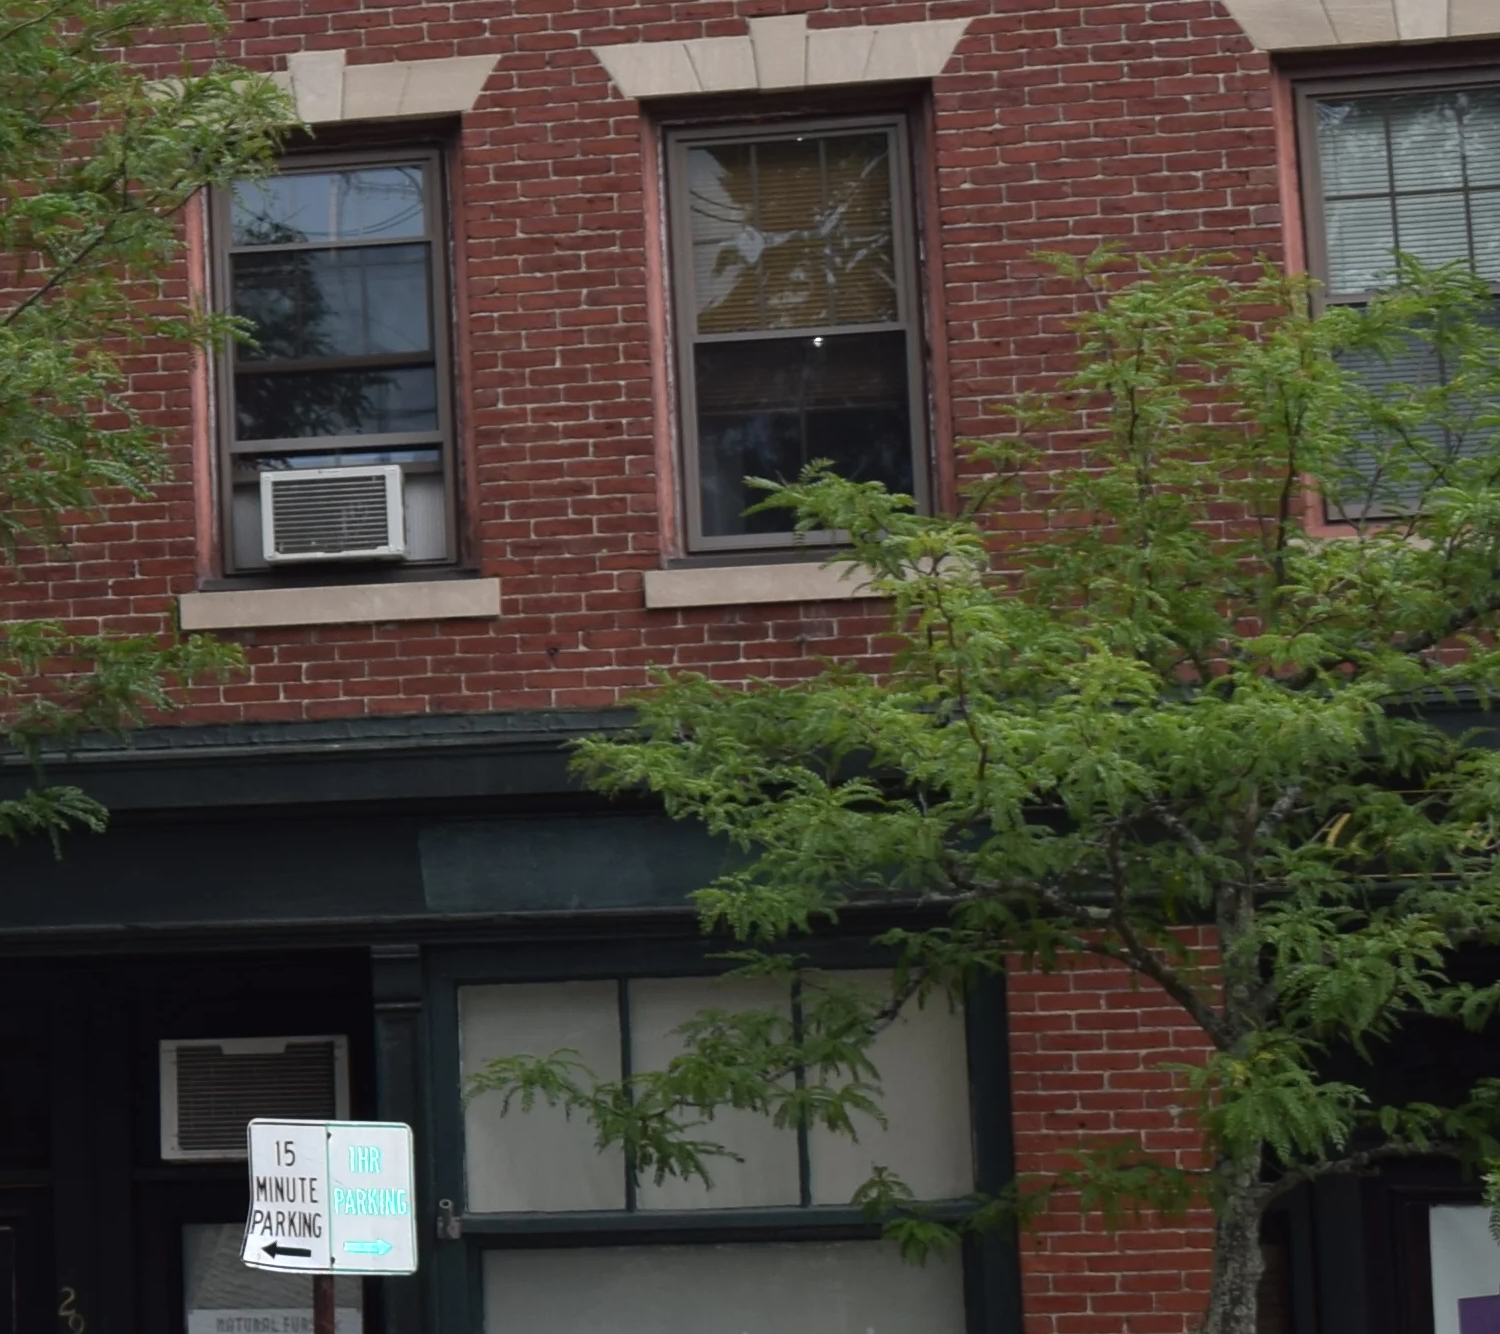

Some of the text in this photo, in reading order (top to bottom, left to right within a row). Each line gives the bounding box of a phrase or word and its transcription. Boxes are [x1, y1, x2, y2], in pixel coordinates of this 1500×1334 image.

[275, 1140, 296, 1167] 15
[256, 1175, 319, 1204] MINUTE
[333, 1186, 408, 1216] PARKING
[250, 1209, 322, 1238] PARKING
